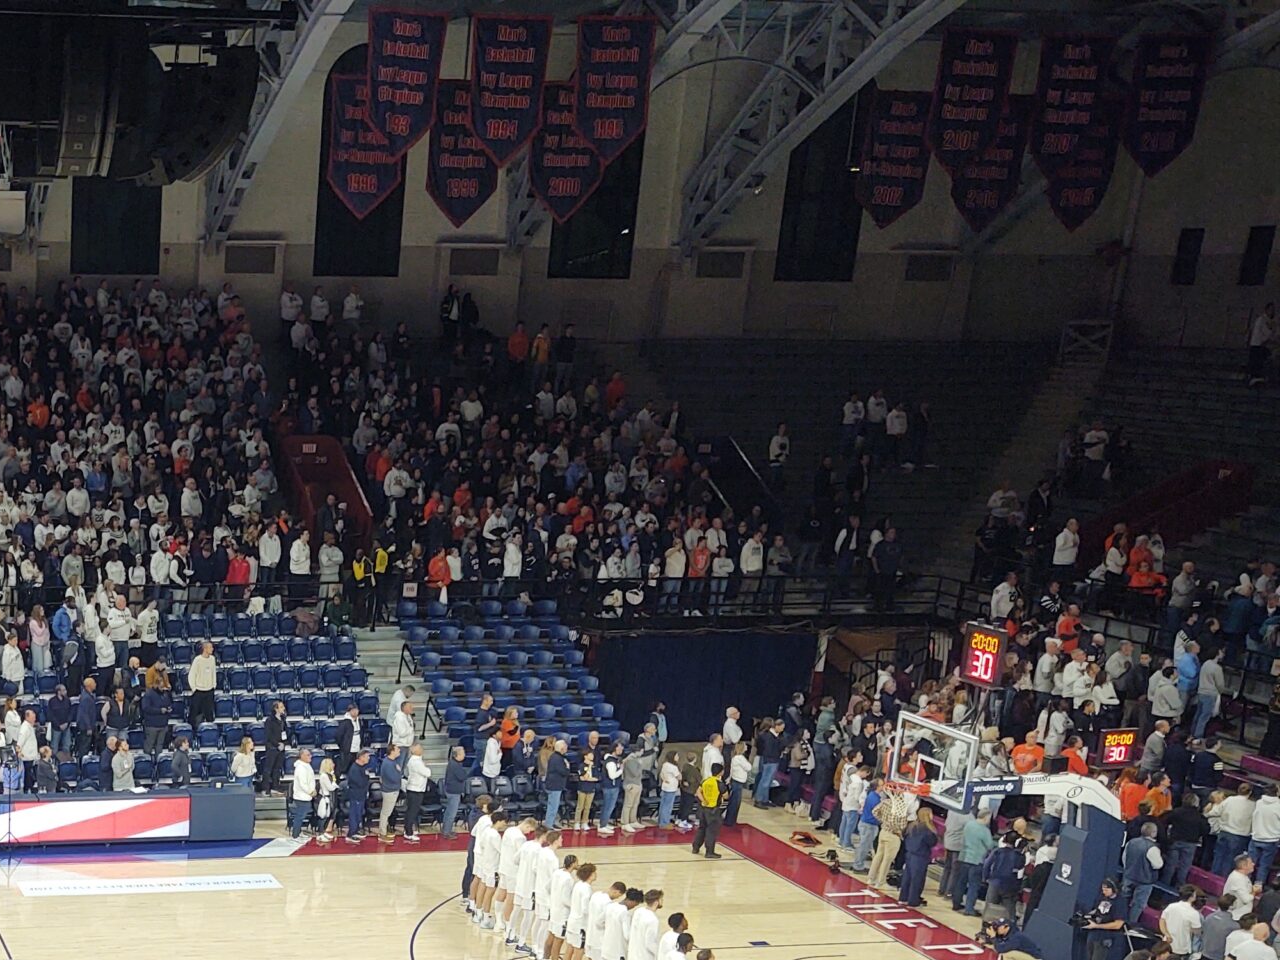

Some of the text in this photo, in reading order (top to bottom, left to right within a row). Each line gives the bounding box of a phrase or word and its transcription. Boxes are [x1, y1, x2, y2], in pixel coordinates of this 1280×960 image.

[485, 47, 535, 64] Basketball
[480, 71, 532, 89] Ivy League
[480, 93, 531, 110] Champions
[971, 632, 999, 653] 20:00
[970, 650, 993, 681] 30
[1105, 733, 1134, 746] 20:00
[1108, 747, 1126, 762] 30
[824, 888, 939, 931] THE
